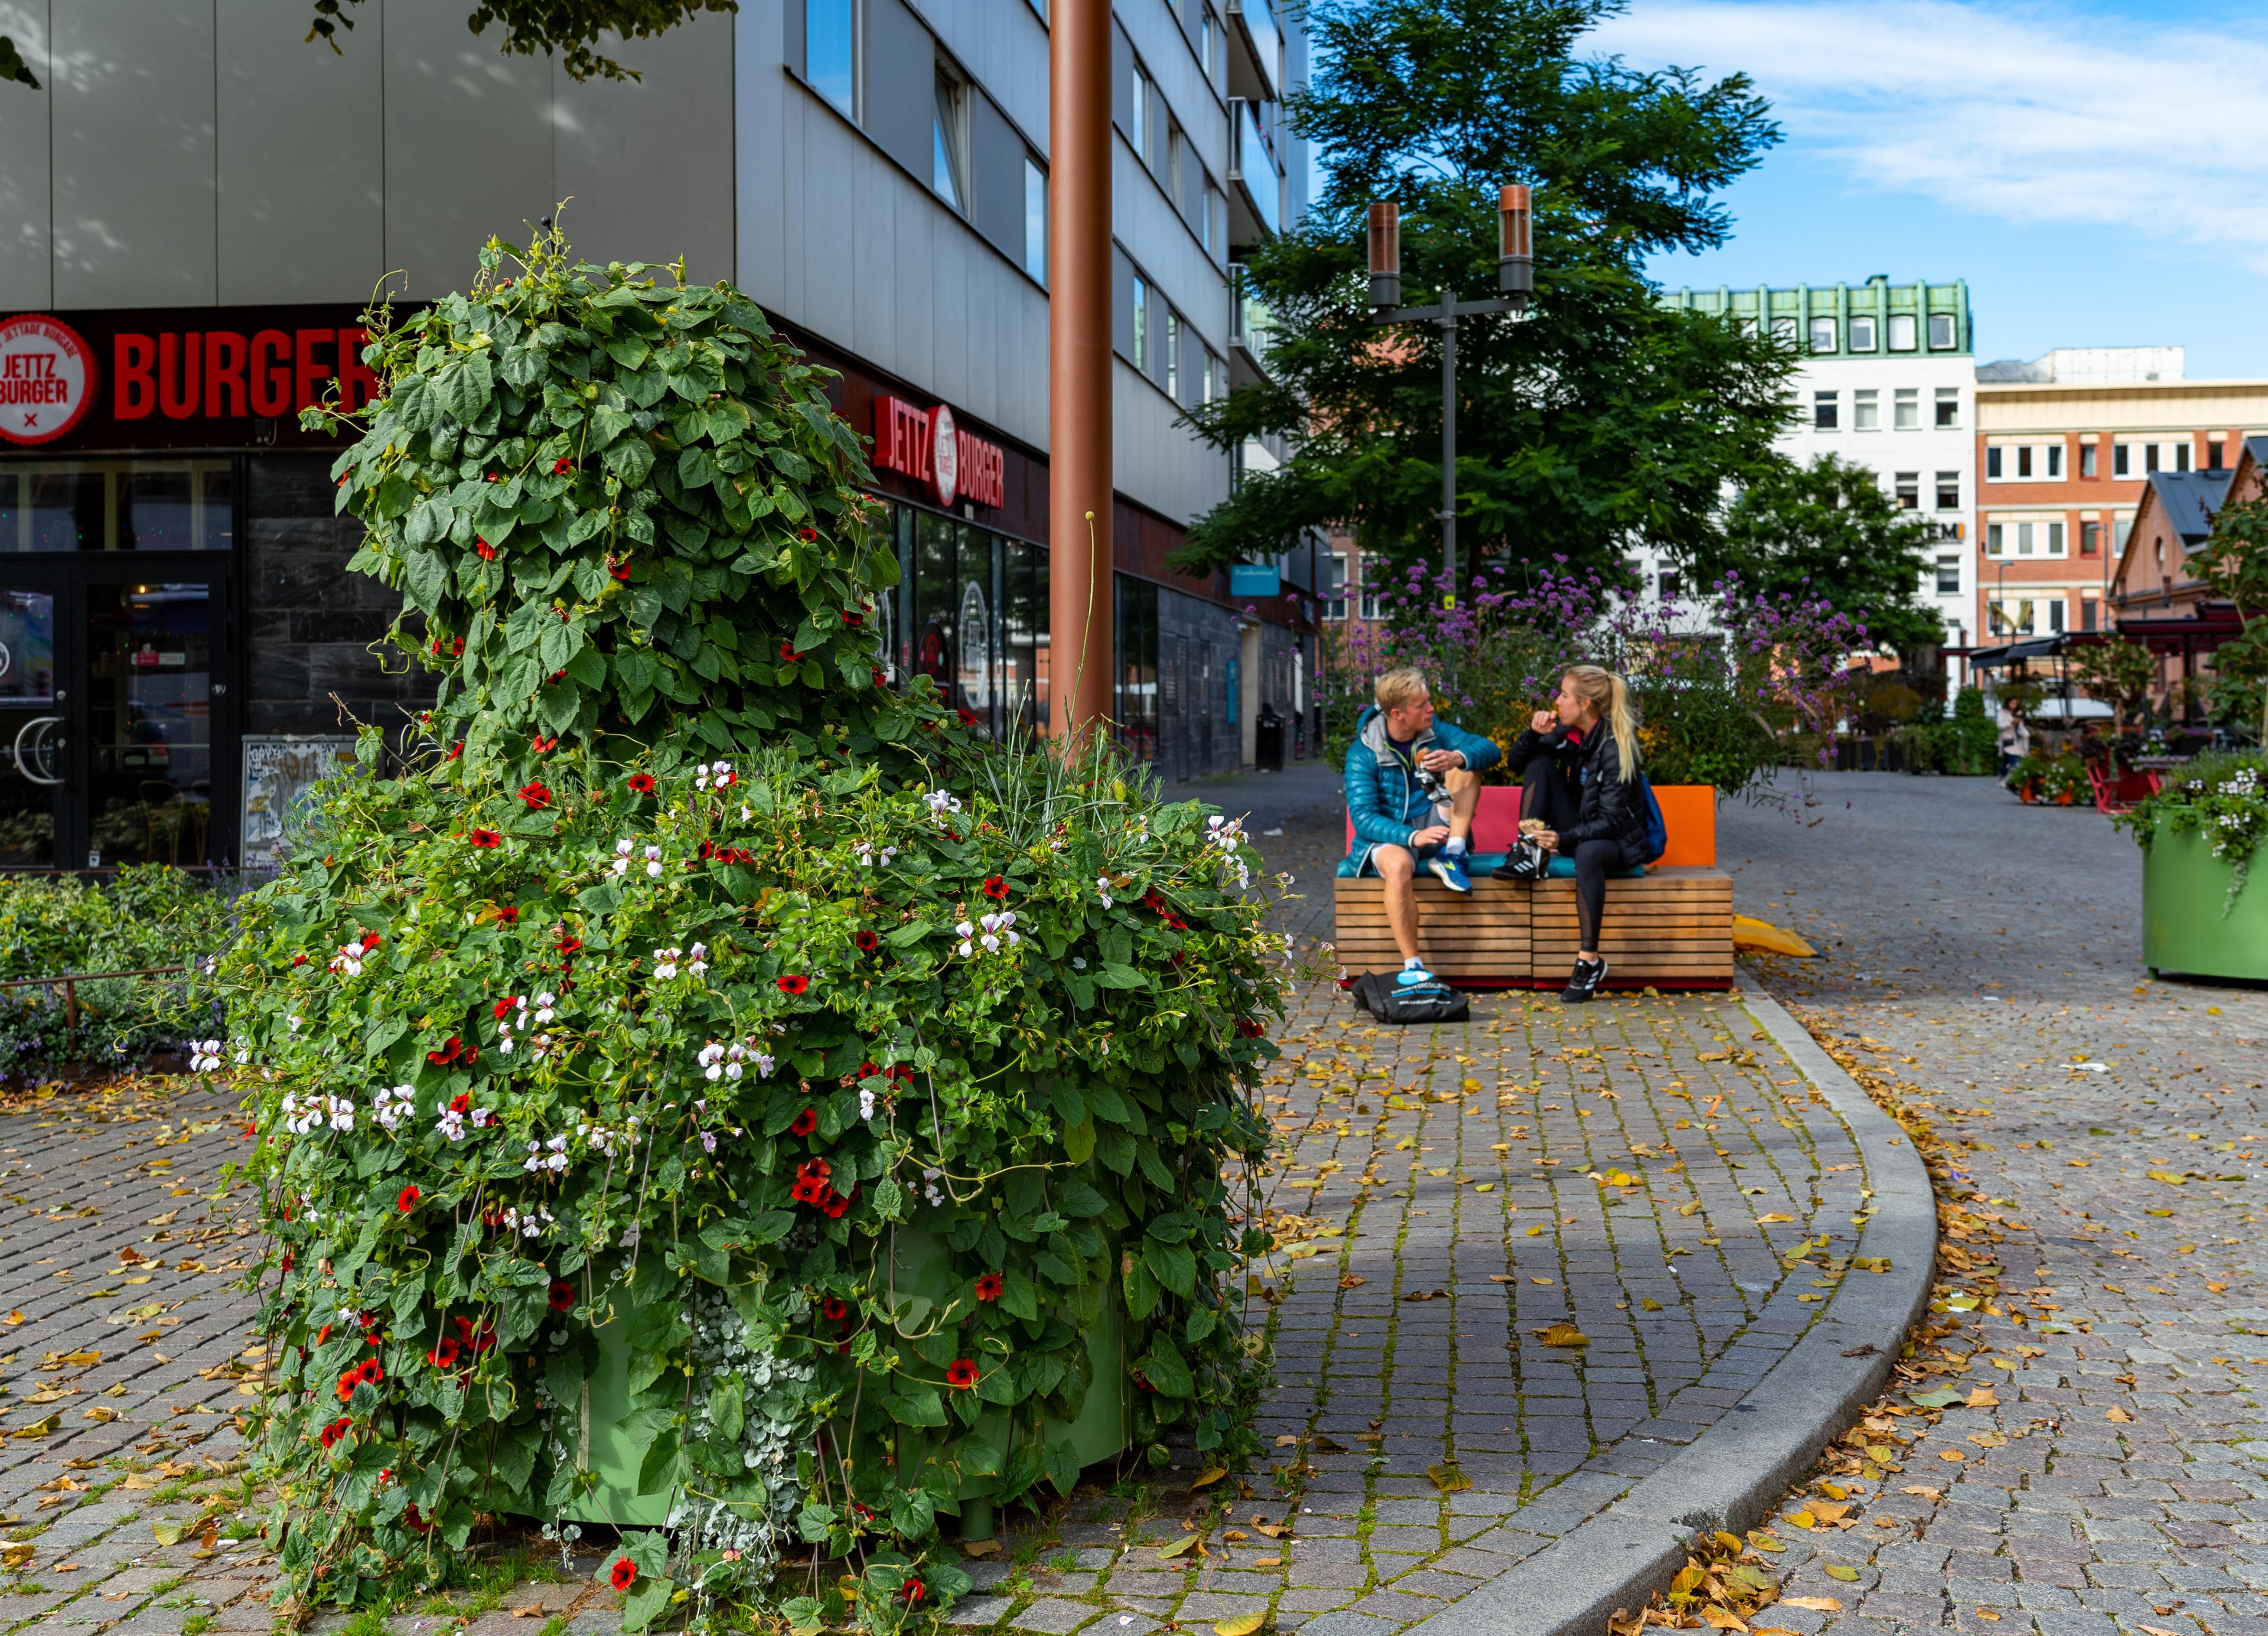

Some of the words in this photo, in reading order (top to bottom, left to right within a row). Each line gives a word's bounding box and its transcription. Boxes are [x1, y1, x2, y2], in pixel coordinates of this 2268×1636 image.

[3, 354, 56, 379] JETTZ
[115, 329, 384, 421] BURGER
[888, 396, 931, 483] JETTZ
[959, 429, 1004, 510] BURGER
